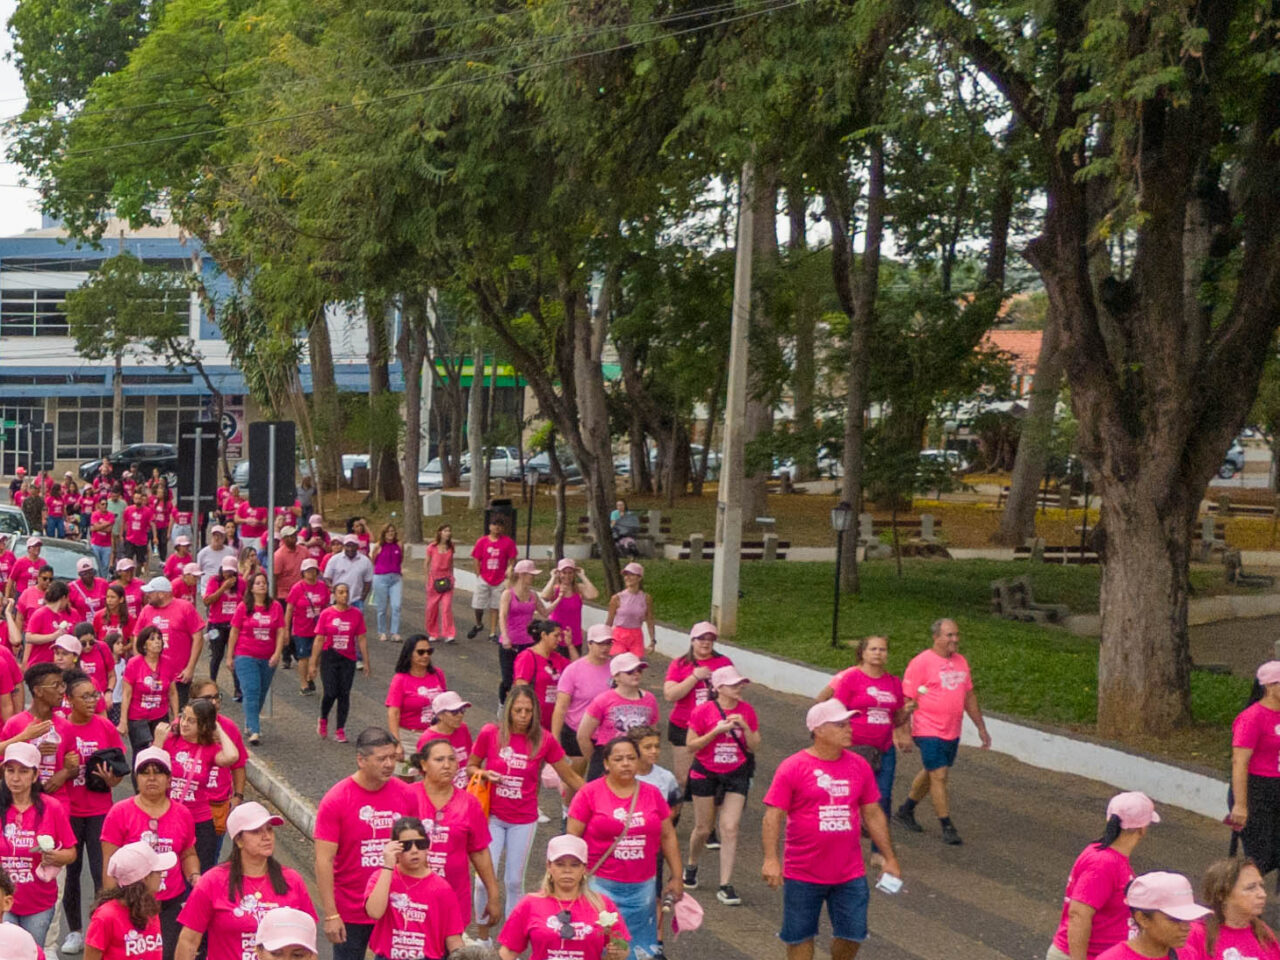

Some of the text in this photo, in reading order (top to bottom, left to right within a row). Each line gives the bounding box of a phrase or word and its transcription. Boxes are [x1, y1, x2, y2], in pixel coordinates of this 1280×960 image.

[819, 821, 852, 832] ROSA
[614, 849, 644, 860] ROSA
[361, 856, 384, 867] ROS
[10, 872, 34, 883] OSA
[125, 933, 163, 957] ROSA
[391, 947, 425, 960] ROSA
